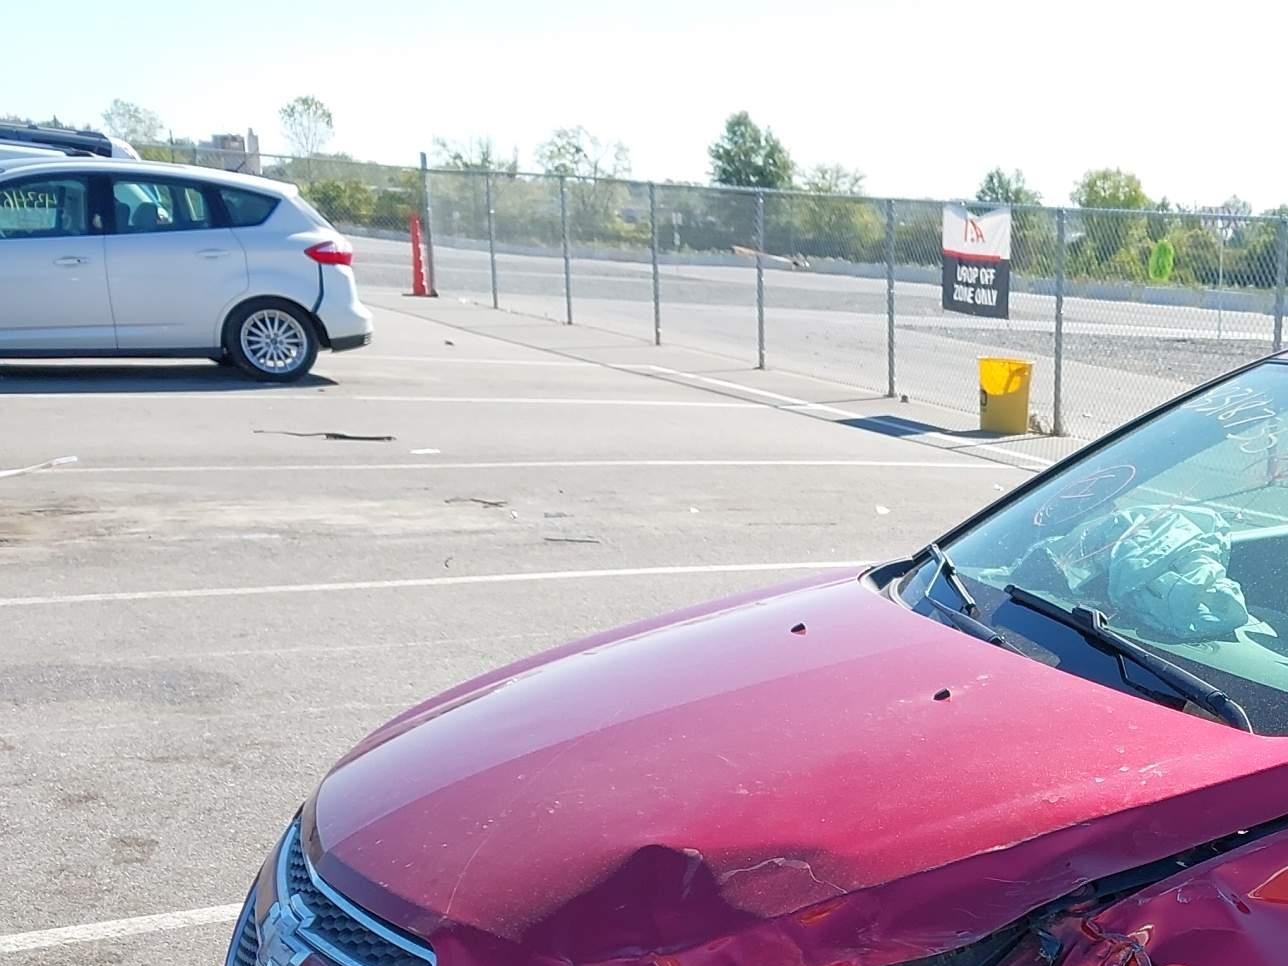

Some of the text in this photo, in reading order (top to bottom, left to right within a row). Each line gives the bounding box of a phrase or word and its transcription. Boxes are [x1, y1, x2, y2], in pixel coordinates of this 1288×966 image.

[979, 267, 997, 285] OFF
[953, 284, 998, 306] ZONE ONLY
